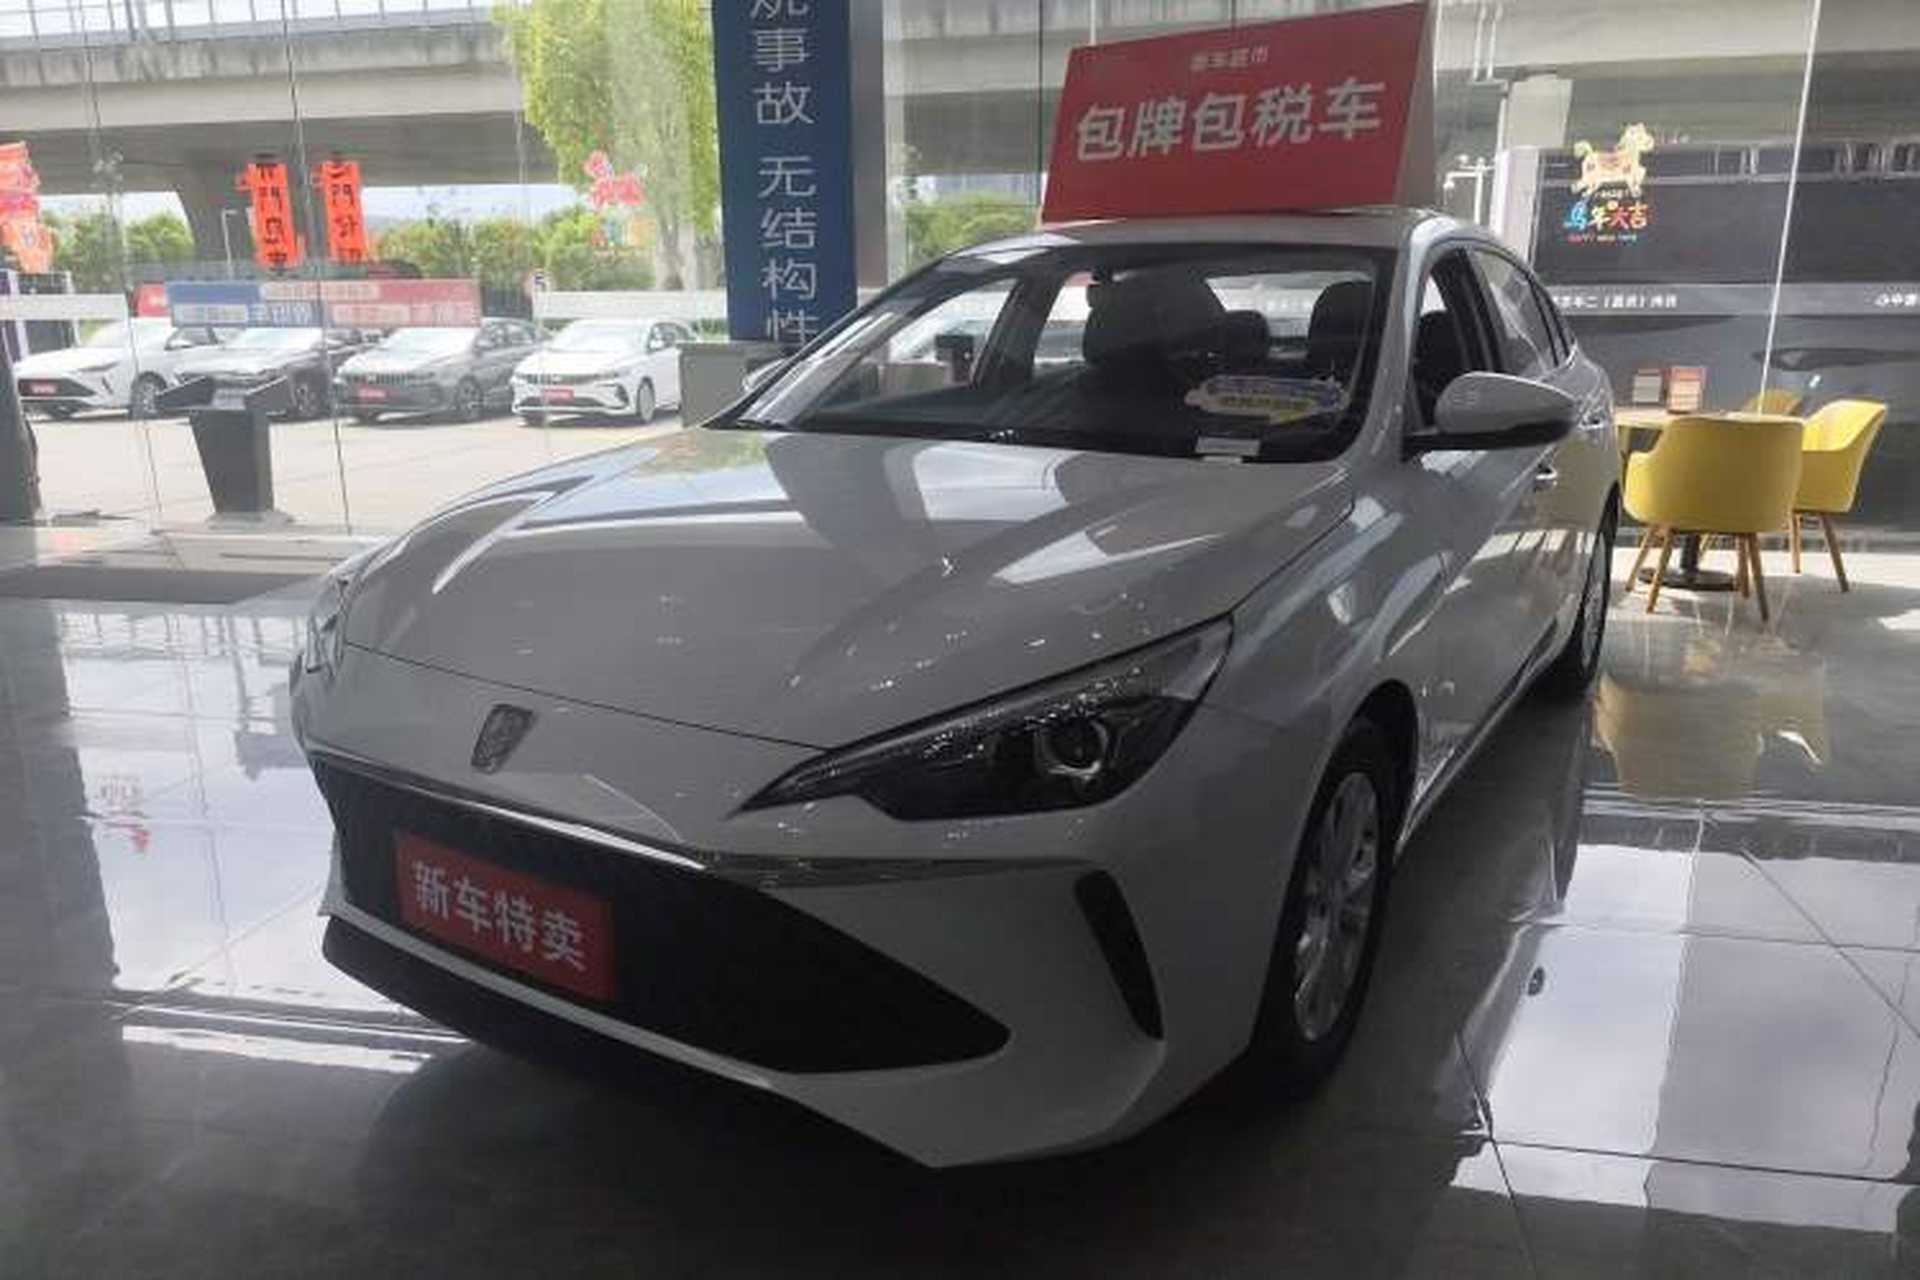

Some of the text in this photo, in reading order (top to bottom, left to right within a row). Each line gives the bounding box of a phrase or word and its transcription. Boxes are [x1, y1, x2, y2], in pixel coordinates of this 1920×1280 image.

[1077, 76, 1386, 162] 包牌包税车
[1563, 200, 1648, 231] 马年大吉
[411, 860, 587, 971] 新车特卖
